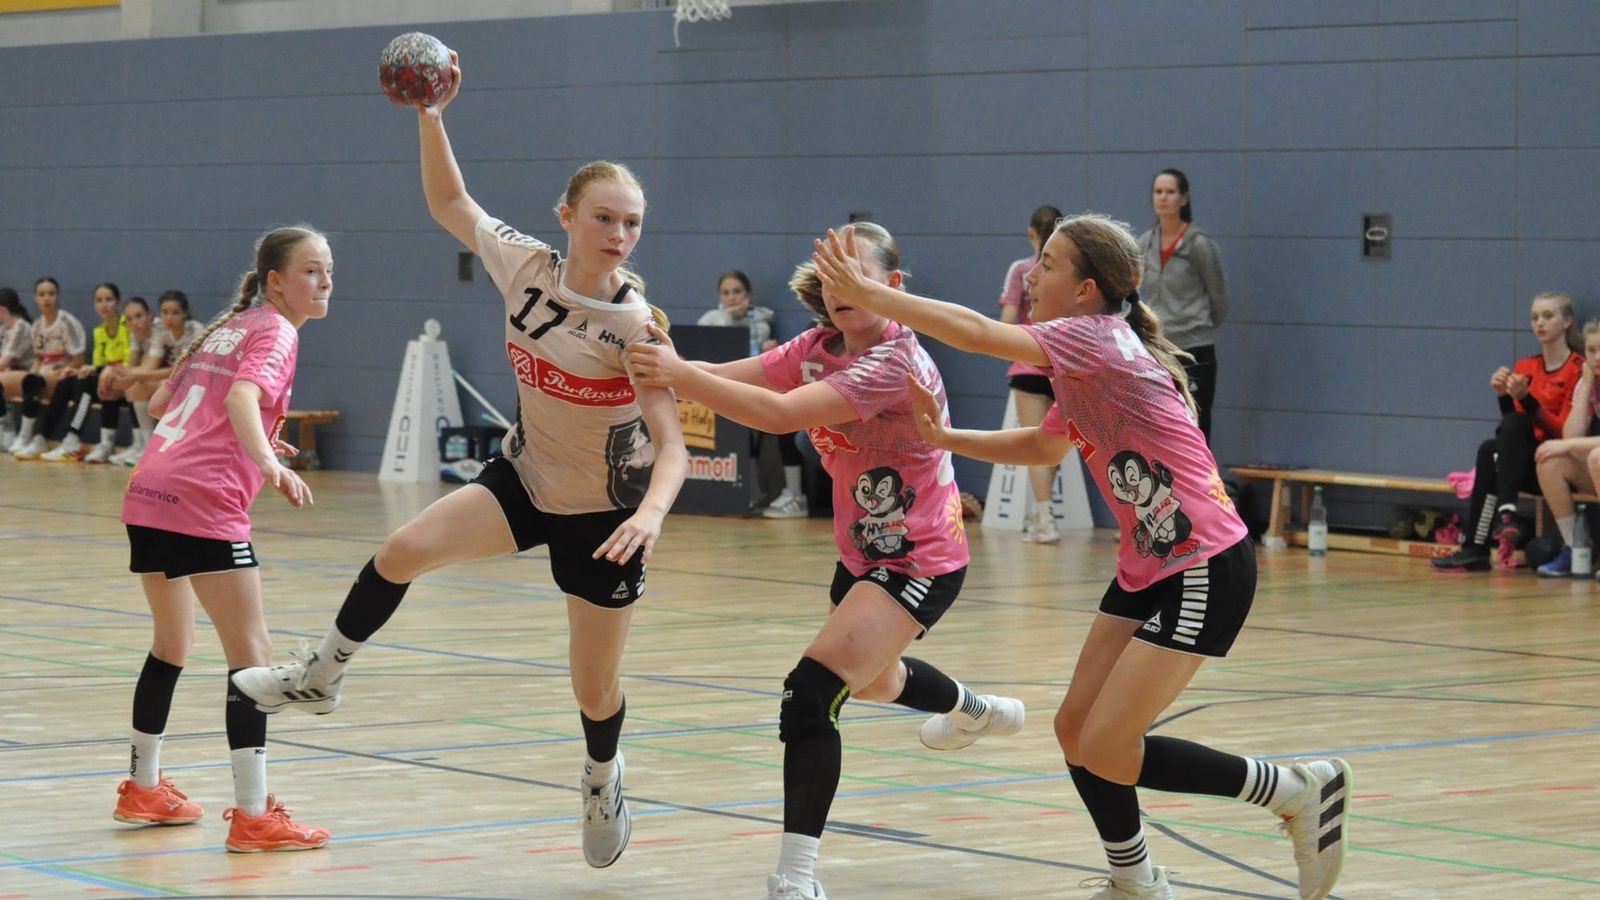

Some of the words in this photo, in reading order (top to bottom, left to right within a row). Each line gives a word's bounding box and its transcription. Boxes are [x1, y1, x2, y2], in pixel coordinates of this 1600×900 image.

[509, 287, 570, 341] 17
[153, 384, 206, 453] 4
[611, 591, 629, 599] SELECT
